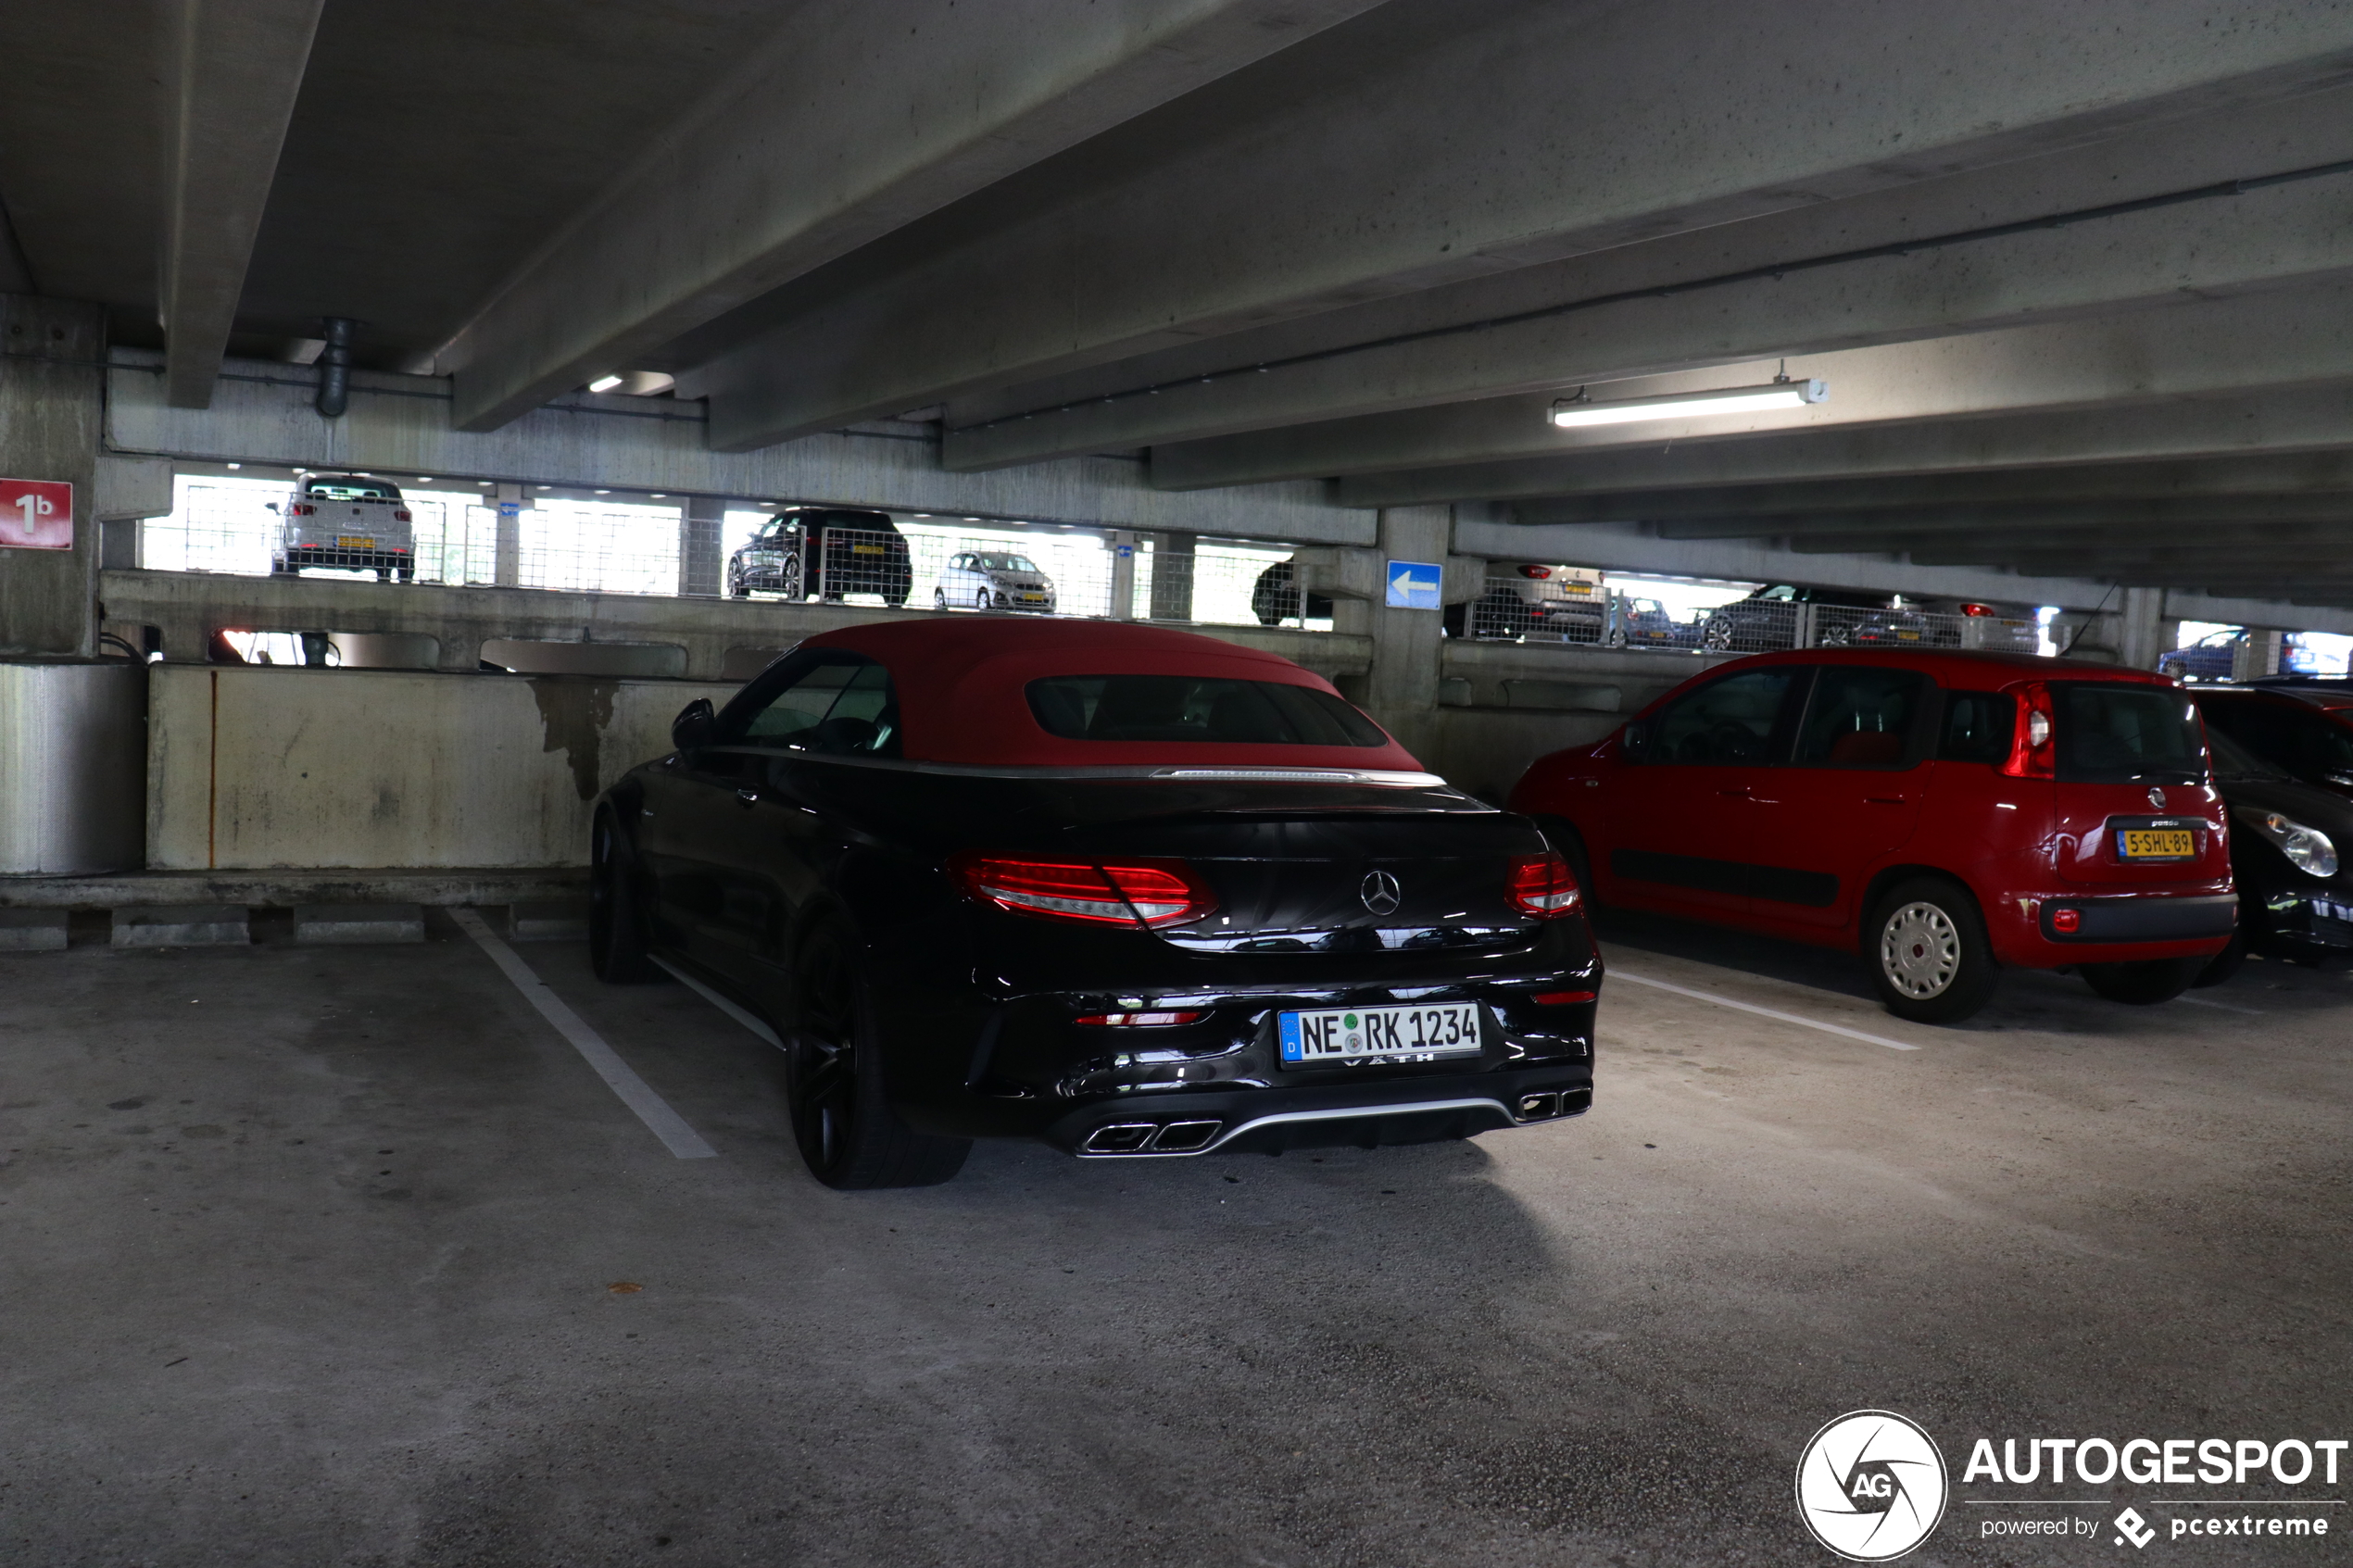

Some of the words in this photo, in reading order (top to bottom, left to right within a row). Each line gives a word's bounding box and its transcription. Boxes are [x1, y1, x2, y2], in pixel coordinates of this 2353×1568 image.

[16, 495, 53, 533] 1b
[2130, 834, 2189, 853] 5-SHL-89
[1302, 1016, 1341, 1054] NE
[1365, 1012, 1403, 1050] RK
[1409, 1009, 1477, 1047] 1234
[1288, 1042, 1296, 1053] D
[1341, 1053, 1434, 1067] VÄTH
